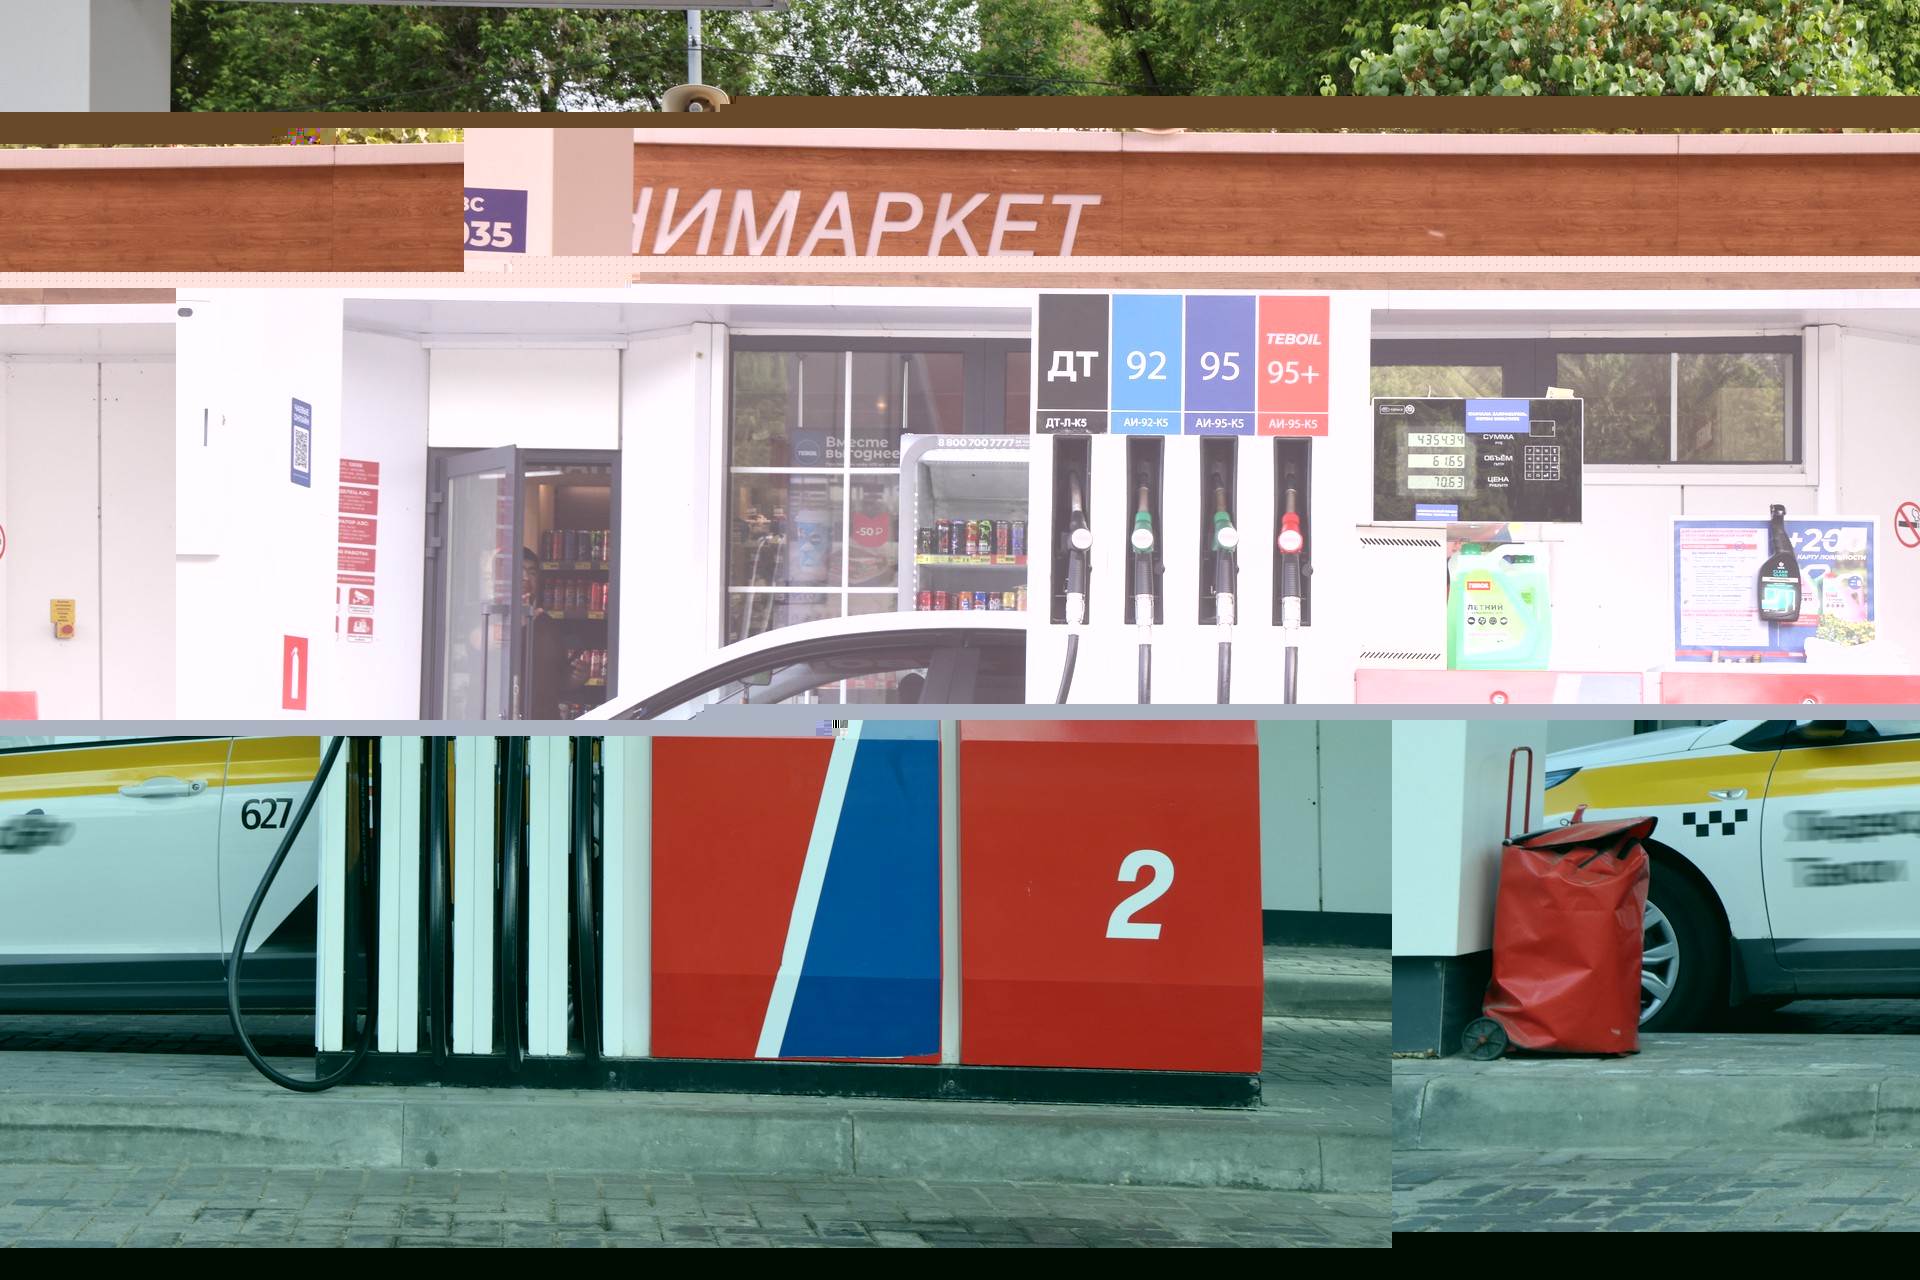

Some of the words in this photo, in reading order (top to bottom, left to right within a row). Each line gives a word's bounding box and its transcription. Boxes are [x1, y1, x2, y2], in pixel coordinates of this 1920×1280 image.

[464, 220, 512, 248] 35
[1266, 333, 1321, 345] TEBOIL
[1047, 351, 1098, 382] ДТ
[1126, 350, 1166, 380] 92
[1200, 351, 1240, 380] 95
[1267, 361, 1319, 384] 95+
[1045, 418, 1087, 428] ДТ-Л-К5
[1123, 418, 1168, 427] АИ-92-К5
[1195, 418, 1244, 428] АИ-95-К5
[1268, 419, 1317, 429] АИ-95-К5
[938, 439, 945, 447] 8
[946, 439, 967, 447] 800
[968, 439, 989, 447] 700
[990, 439, 1014, 447] 7777
[1417, 434, 1464, 446] 4354.34
[1432, 456, 1463, 467] 61.65
[1435, 477, 1463, 488] 70.63
[856, 528, 874, 536] -50
[241, 798, 293, 830] 627
[1106, 849, 1175, 940] 2
